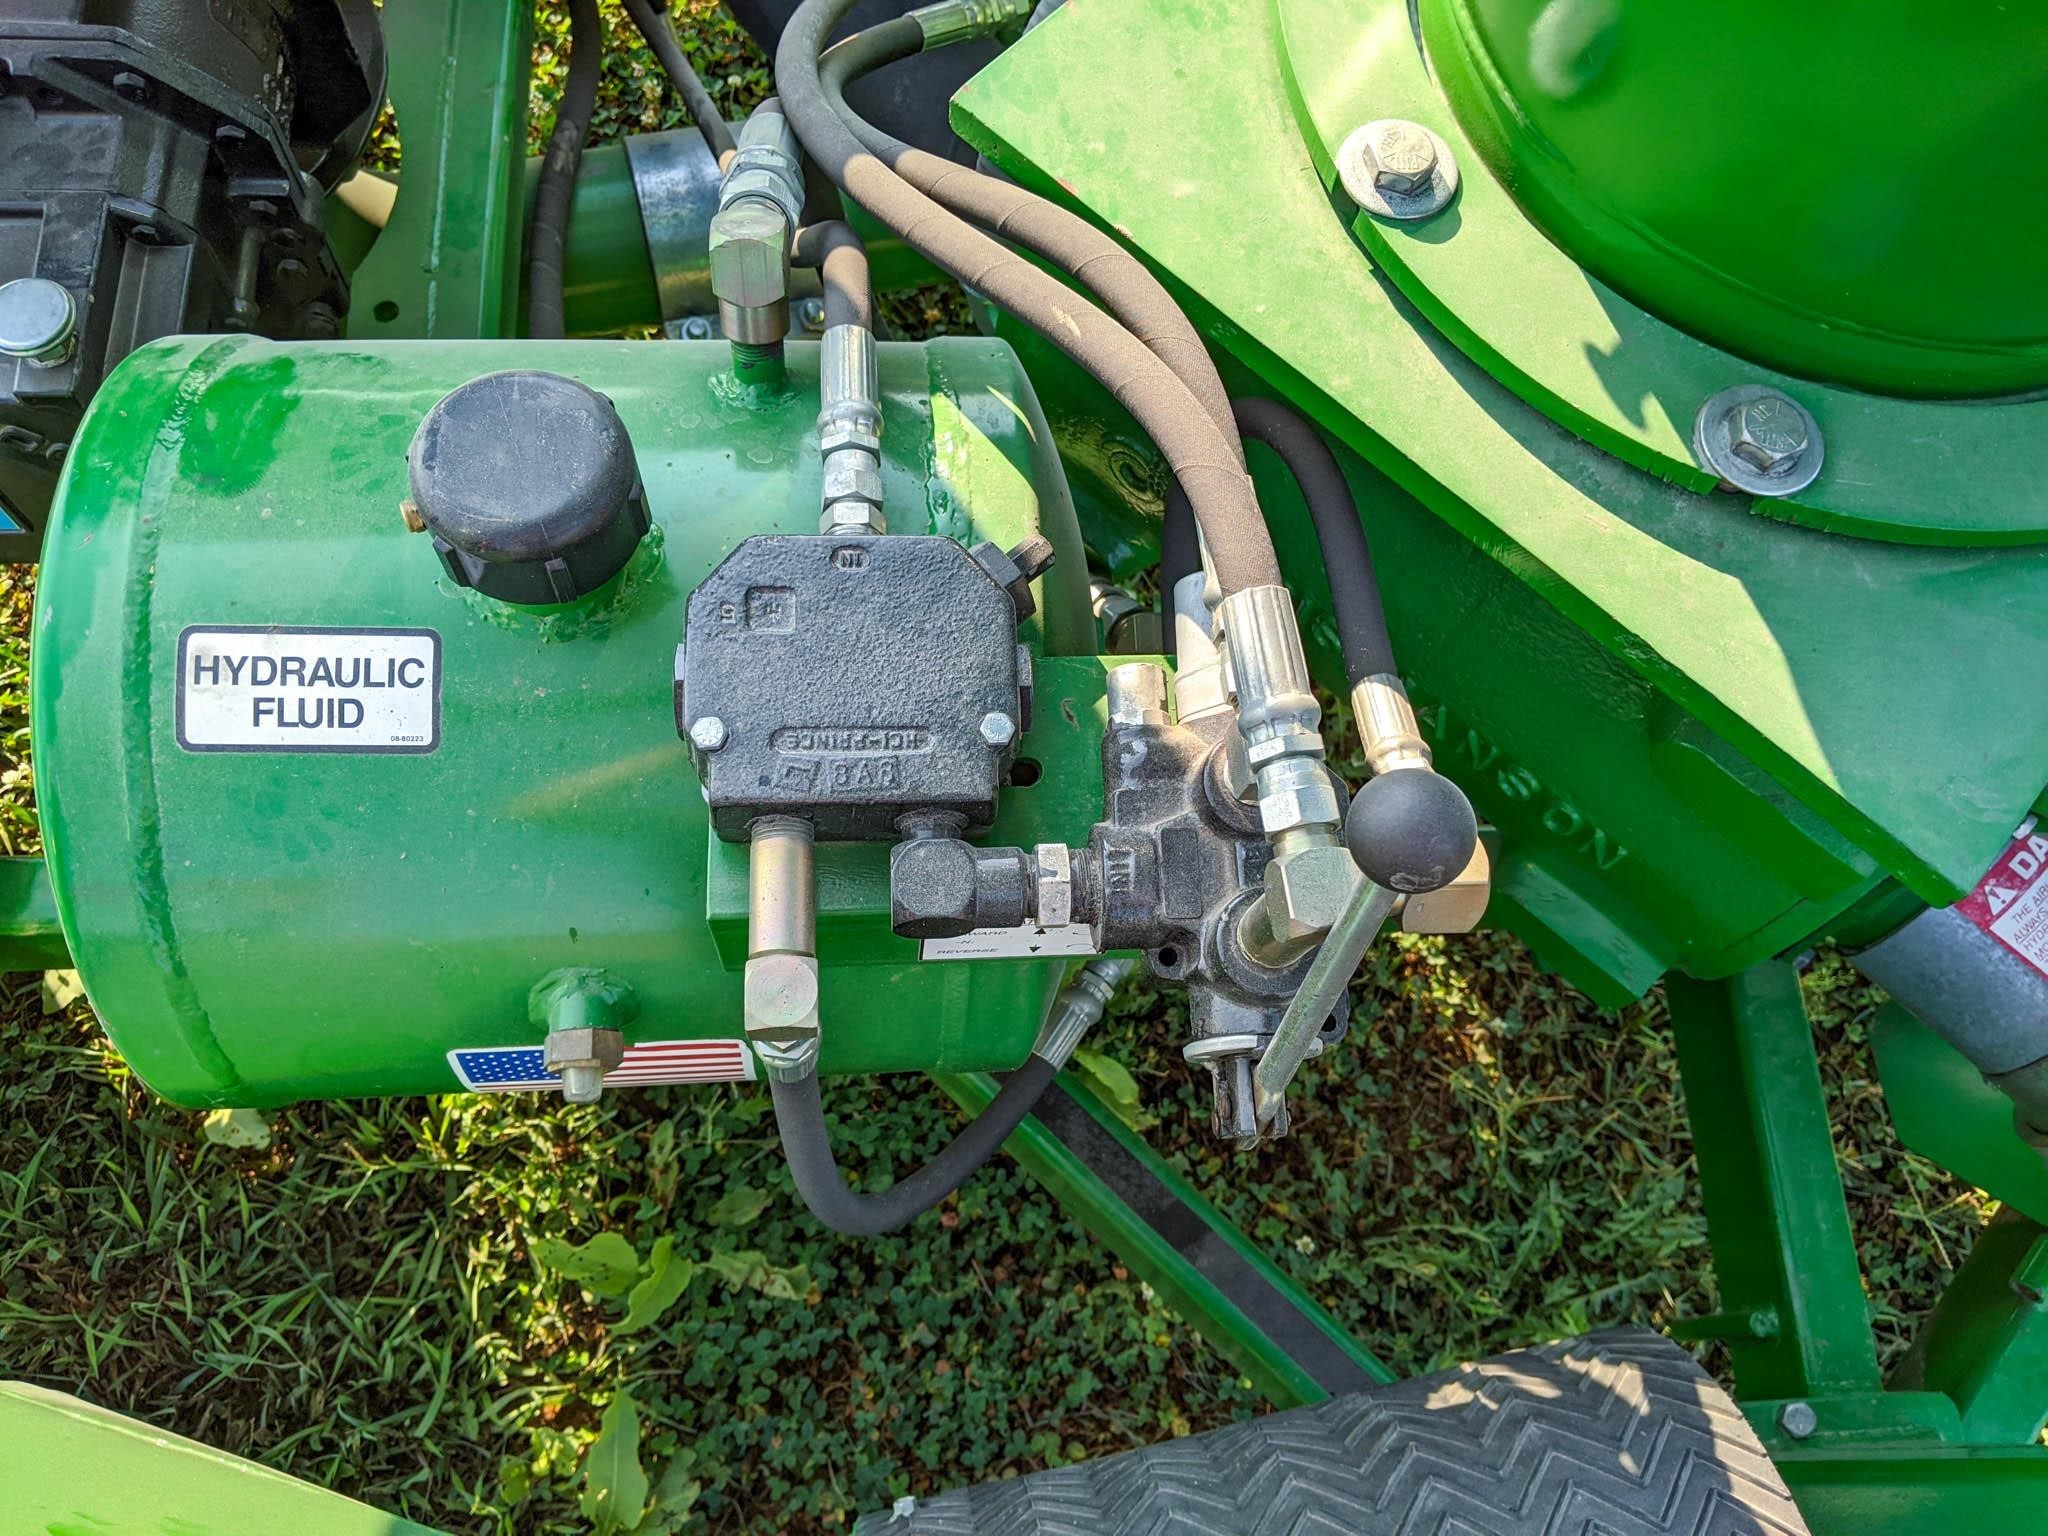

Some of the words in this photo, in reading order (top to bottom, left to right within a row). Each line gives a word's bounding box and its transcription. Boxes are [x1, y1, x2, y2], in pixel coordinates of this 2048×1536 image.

[193, 655, 426, 688] HYDRAULIC
[252, 697, 365, 729] FLUID
[2012, 903, 2033, 925] THE
[2014, 906, 2048, 942] ALWAYS
